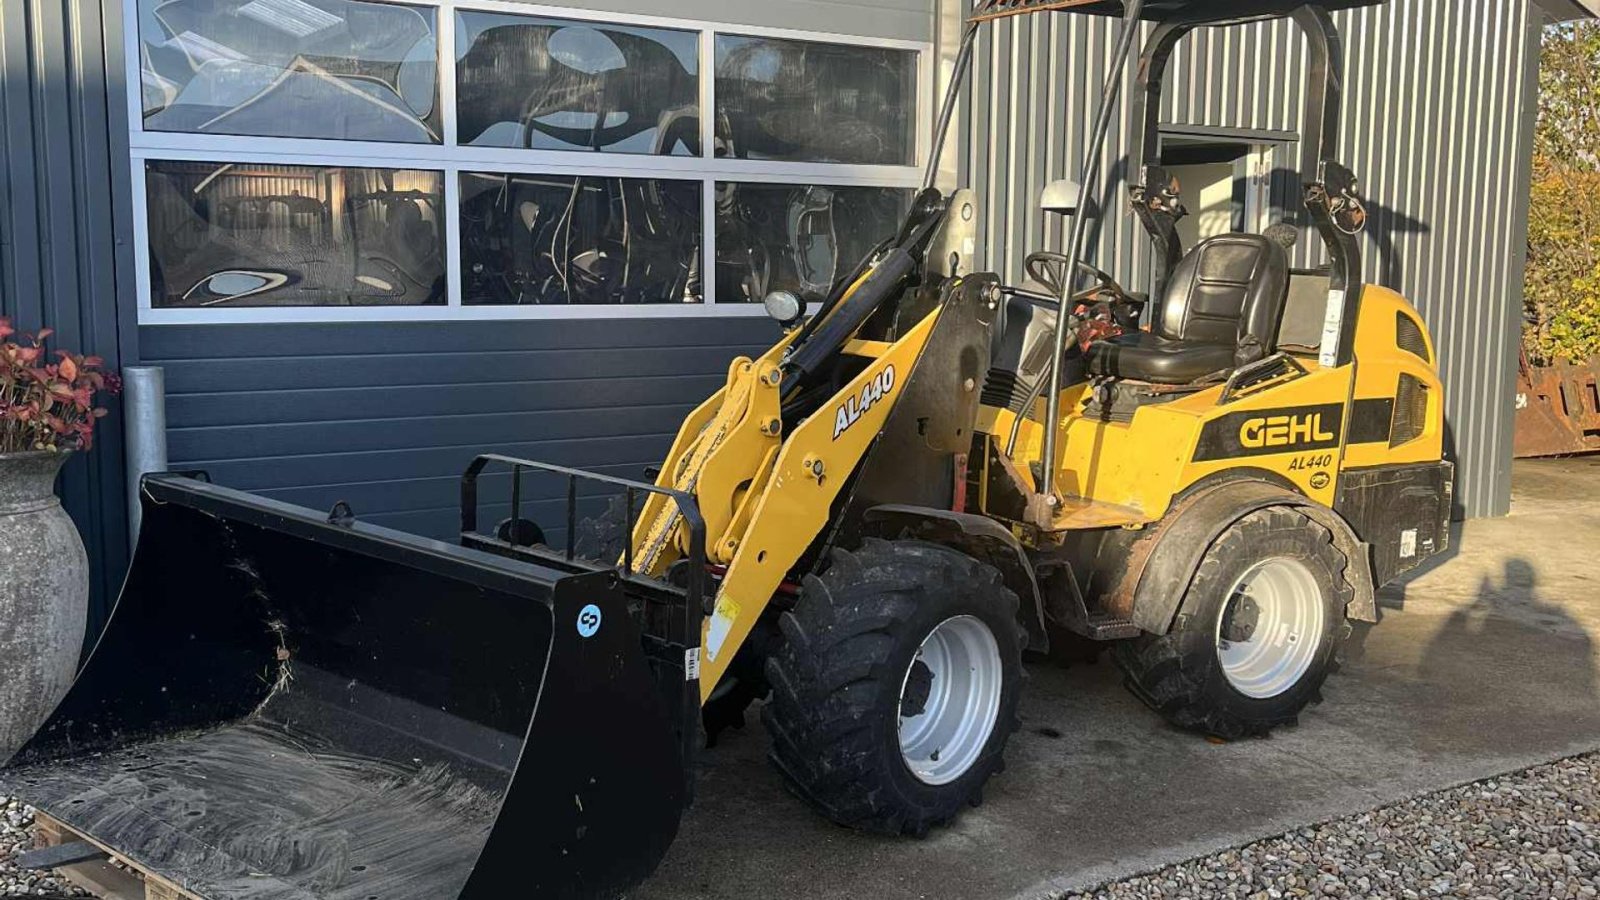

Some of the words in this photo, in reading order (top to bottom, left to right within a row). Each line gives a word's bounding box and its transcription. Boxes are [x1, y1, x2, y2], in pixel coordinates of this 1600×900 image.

[832, 363, 895, 441] AL440
[1240, 412, 1334, 449] GEHL
[1287, 454, 1332, 471] AL440
